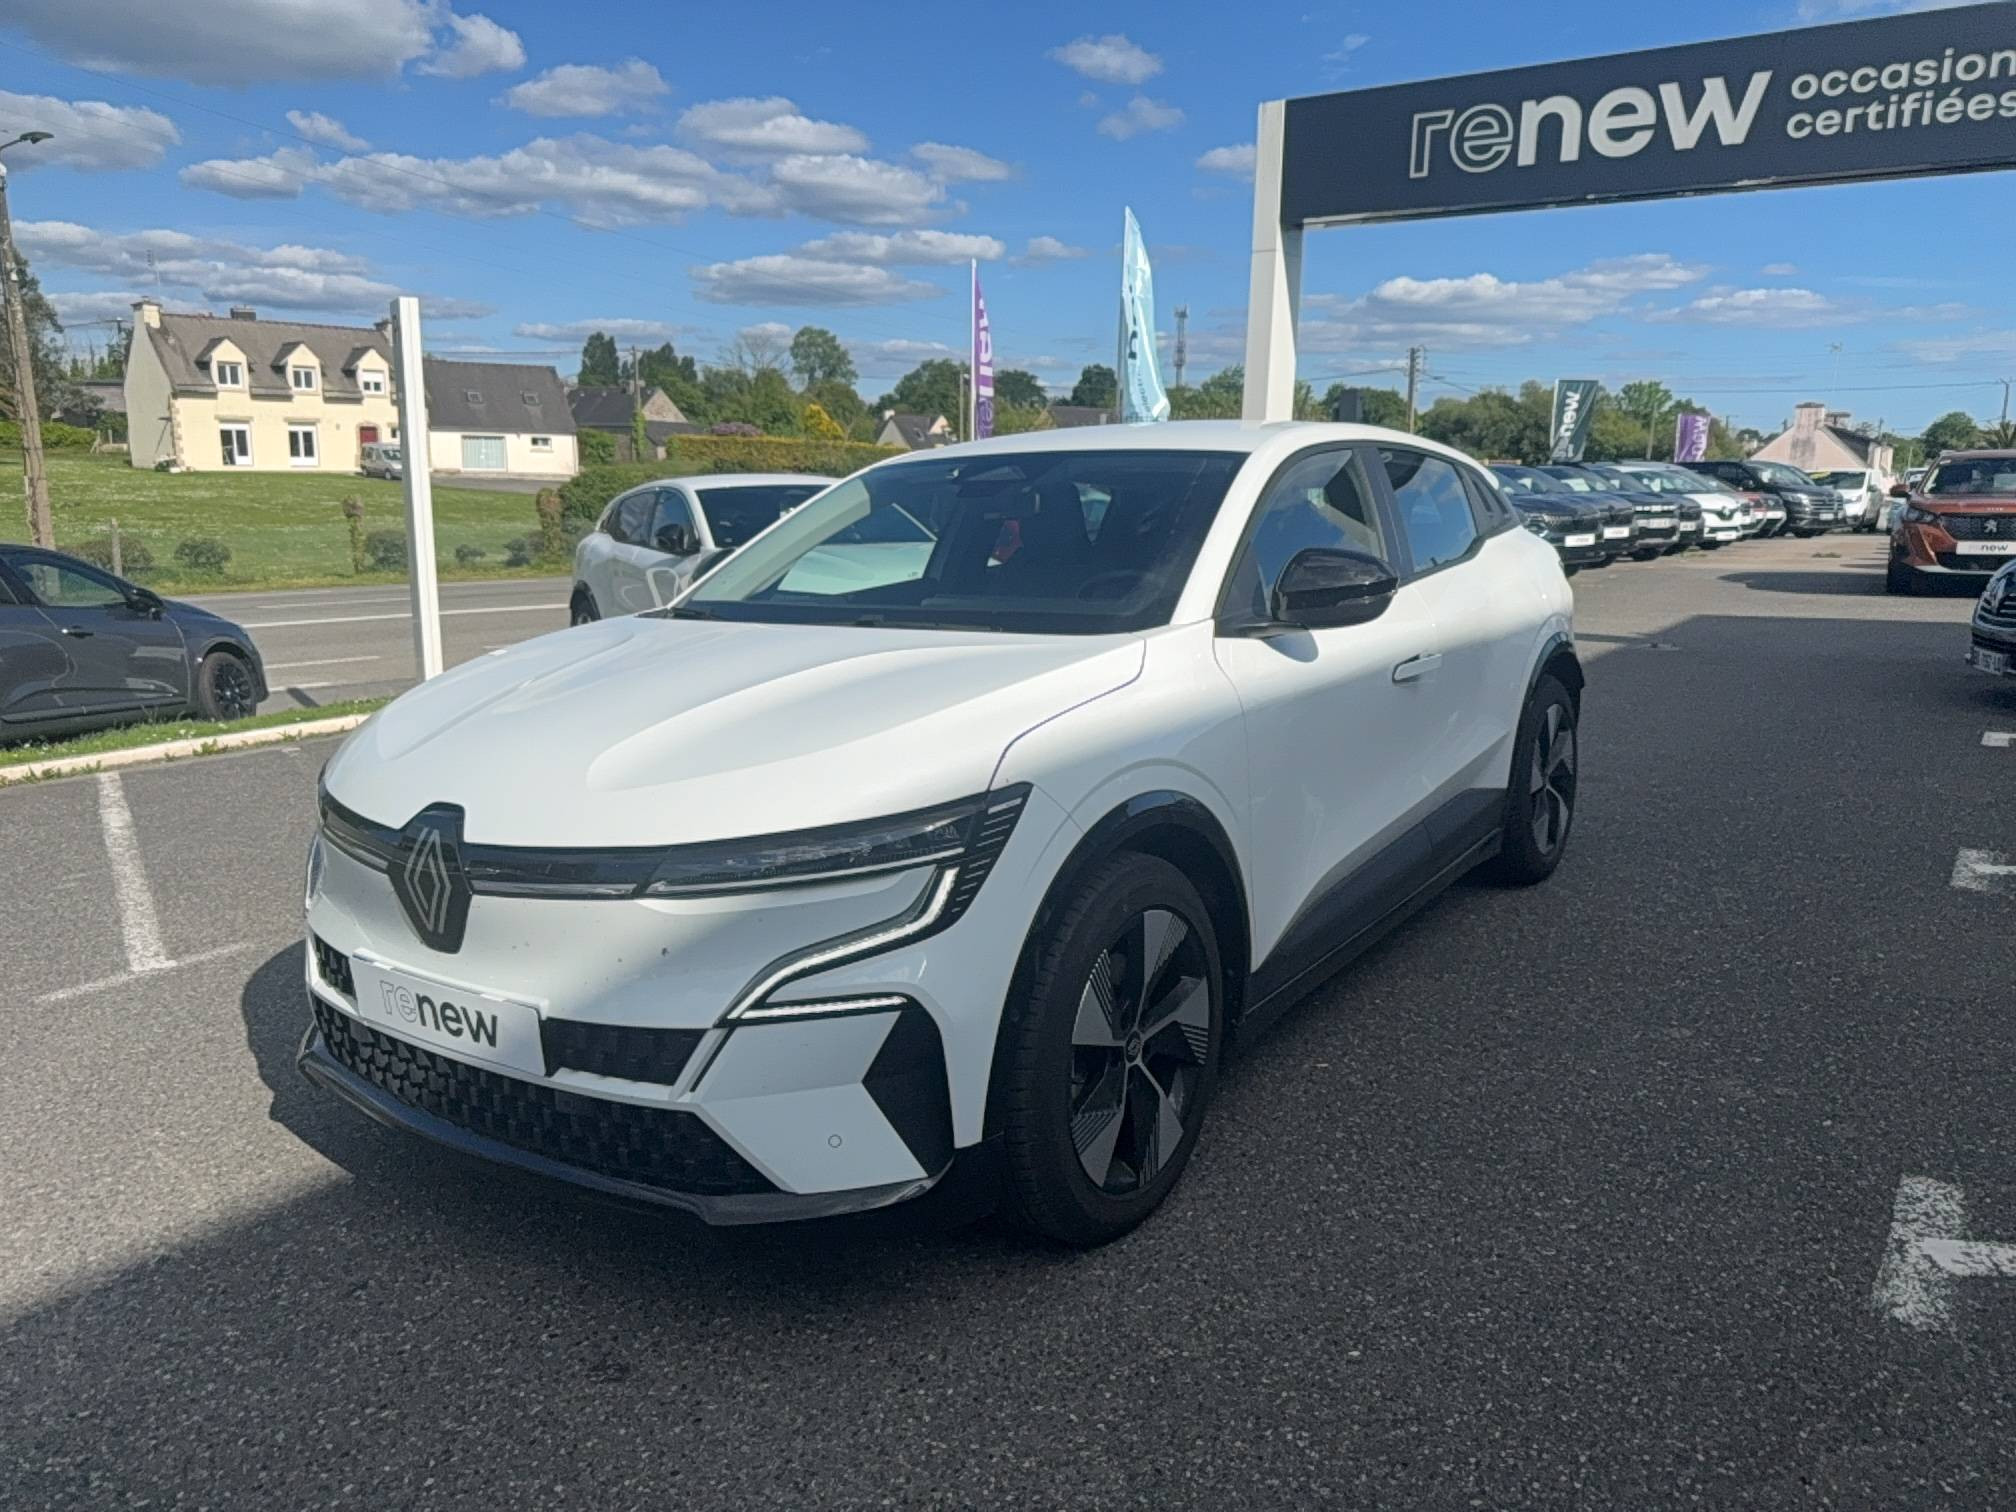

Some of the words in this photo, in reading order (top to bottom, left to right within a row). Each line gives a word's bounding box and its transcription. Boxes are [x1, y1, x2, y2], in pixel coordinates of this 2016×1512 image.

[1790, 47, 2016, 100] occasion
[1409, 71, 1773, 178] renew
[1785, 87, 2016, 139] certifiées
[379, 979, 498, 1048] renew
